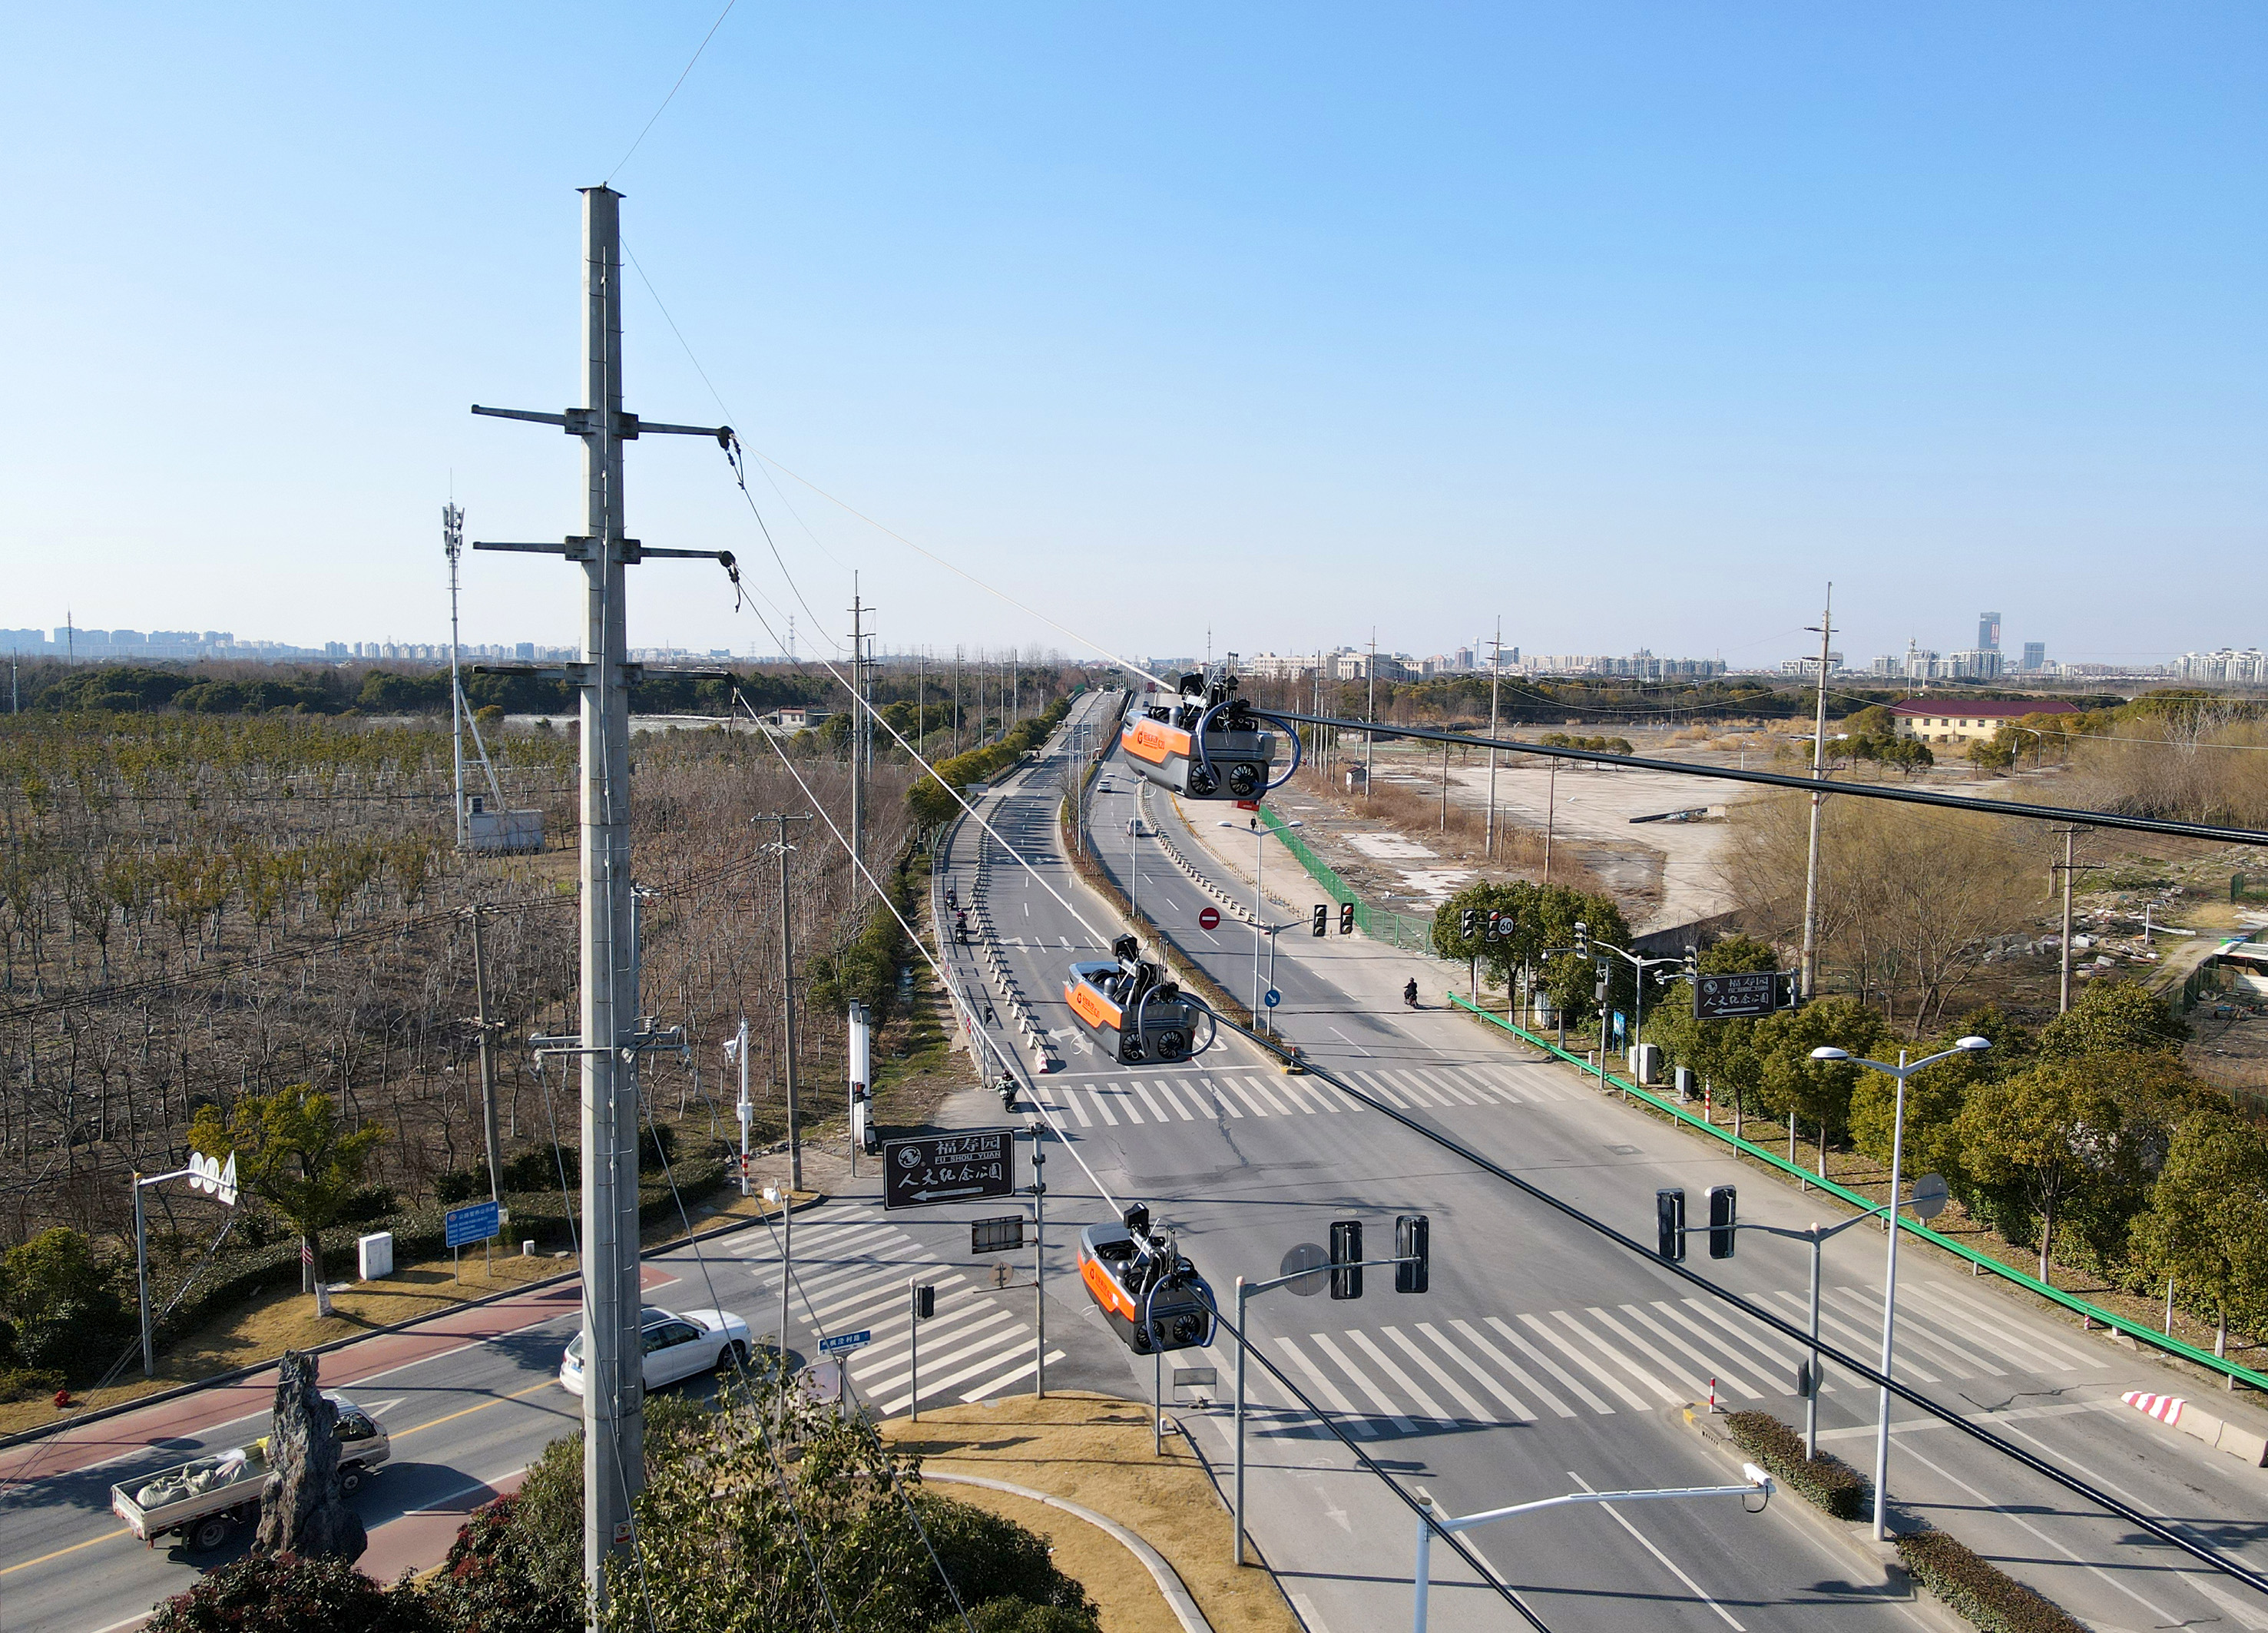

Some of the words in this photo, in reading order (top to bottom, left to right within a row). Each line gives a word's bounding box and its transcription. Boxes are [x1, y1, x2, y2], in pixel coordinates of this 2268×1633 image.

[1500, 922, 1511, 931] 60
[1729, 976, 1769, 988] 福寿园
[935, 1136, 1000, 1155] 福寿园
